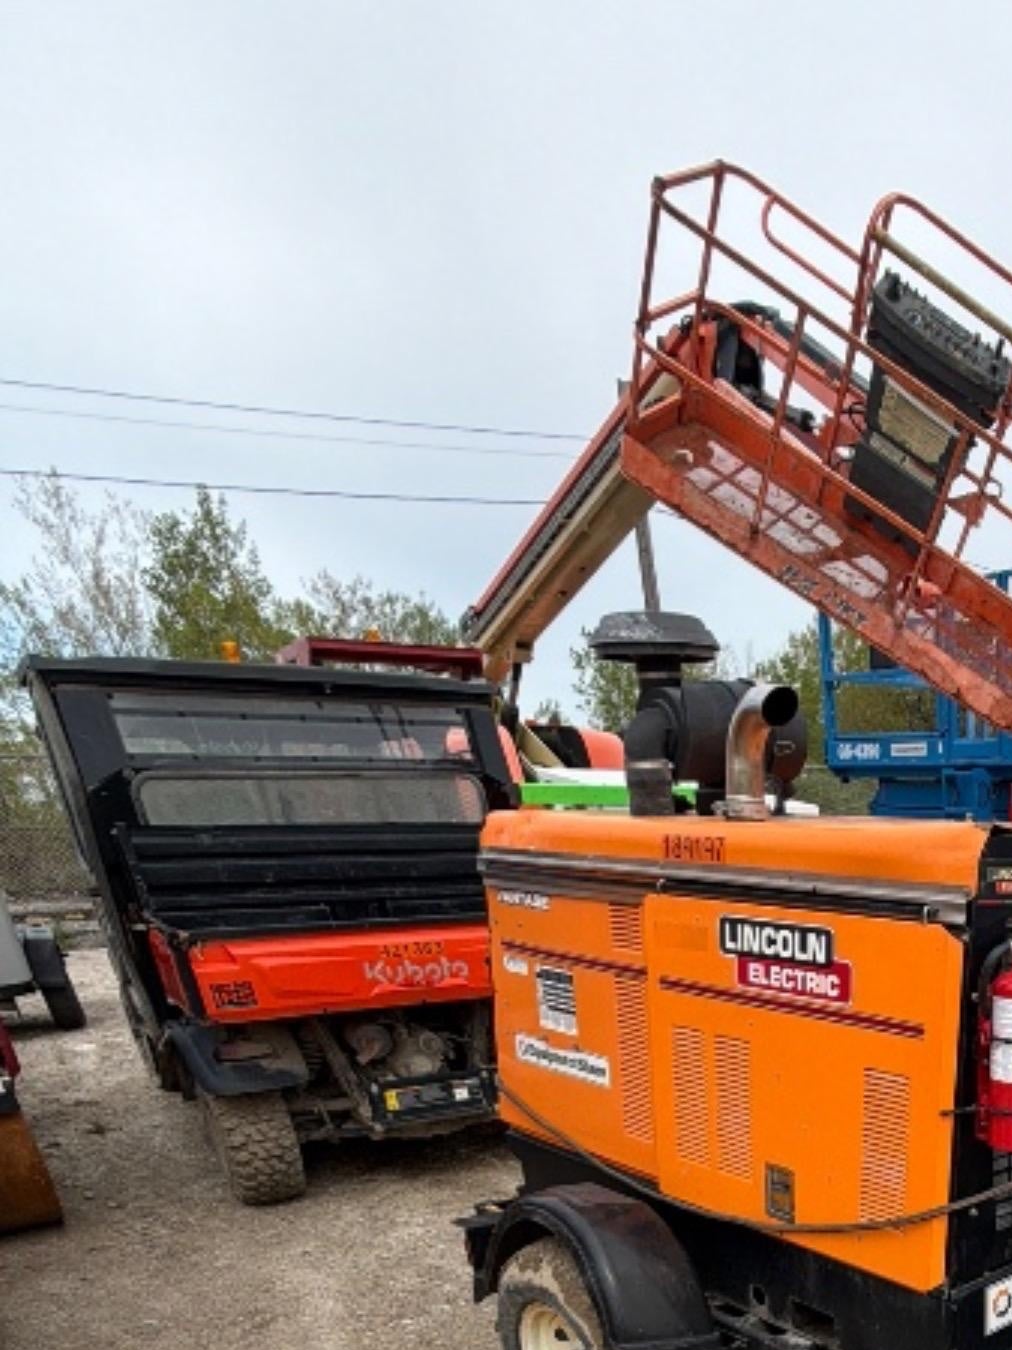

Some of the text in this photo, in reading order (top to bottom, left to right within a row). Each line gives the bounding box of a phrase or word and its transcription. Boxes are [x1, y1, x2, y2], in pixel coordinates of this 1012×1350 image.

[725, 921, 827, 963] LINCOLN
[363, 956, 470, 985] Kubota
[748, 965, 840, 997] ELECTRIC
